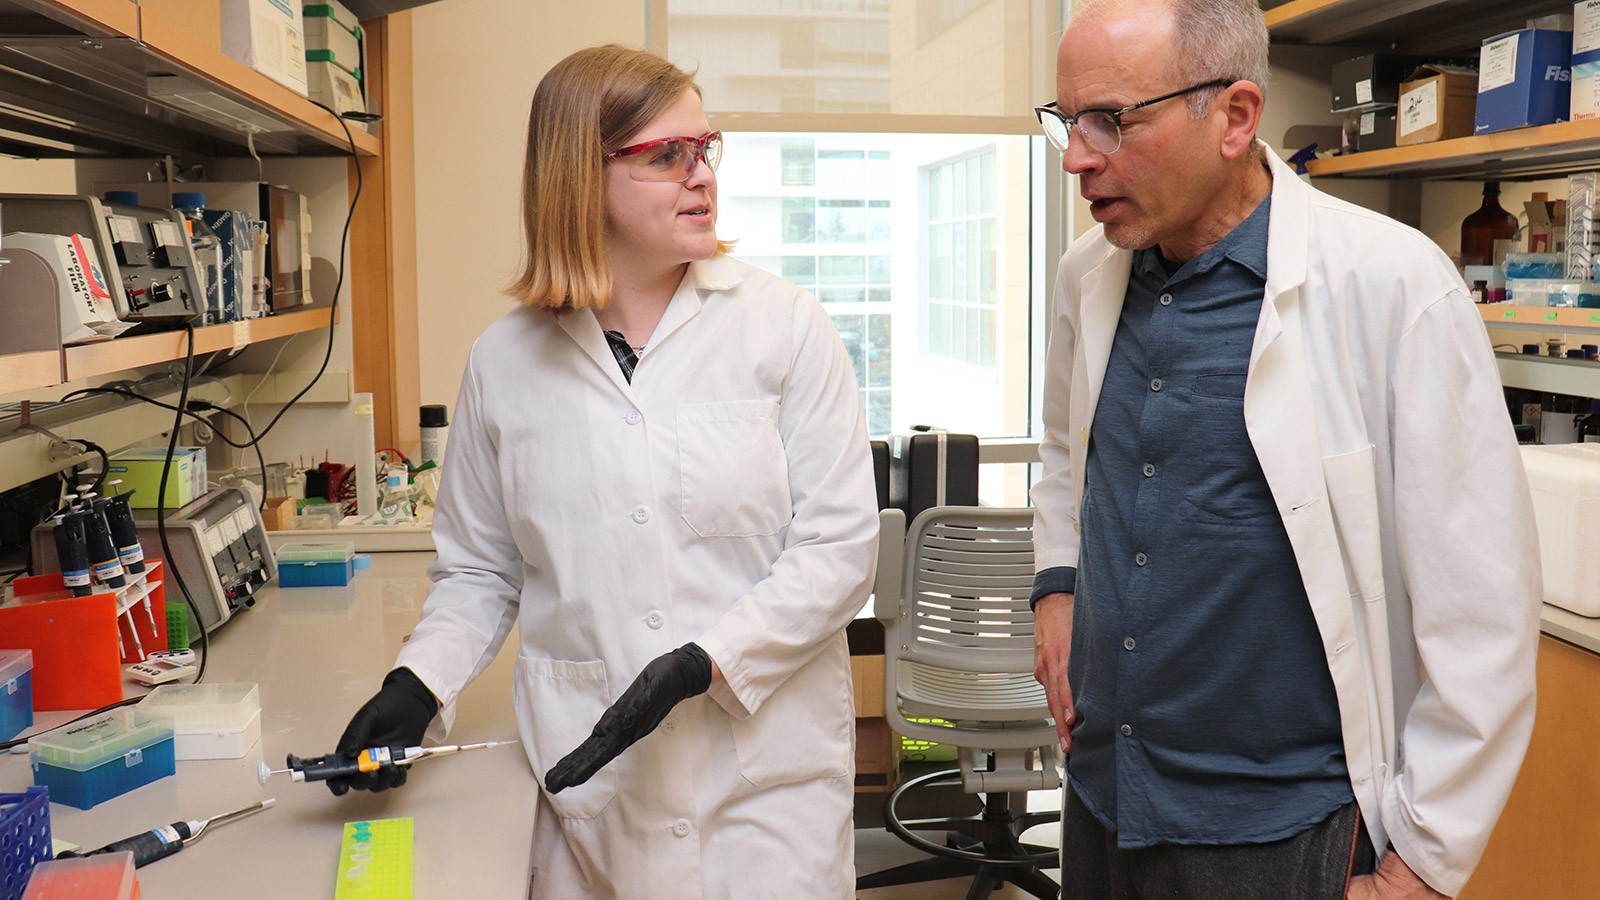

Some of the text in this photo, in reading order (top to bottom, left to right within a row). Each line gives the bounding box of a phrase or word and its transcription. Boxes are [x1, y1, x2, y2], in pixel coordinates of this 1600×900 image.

[1544, 65, 1570, 82] Fis
[1573, 112, 1596, 120] Thermo
[67, 244, 96, 314] LABORATORY
[67, 267, 81, 293] FILM
